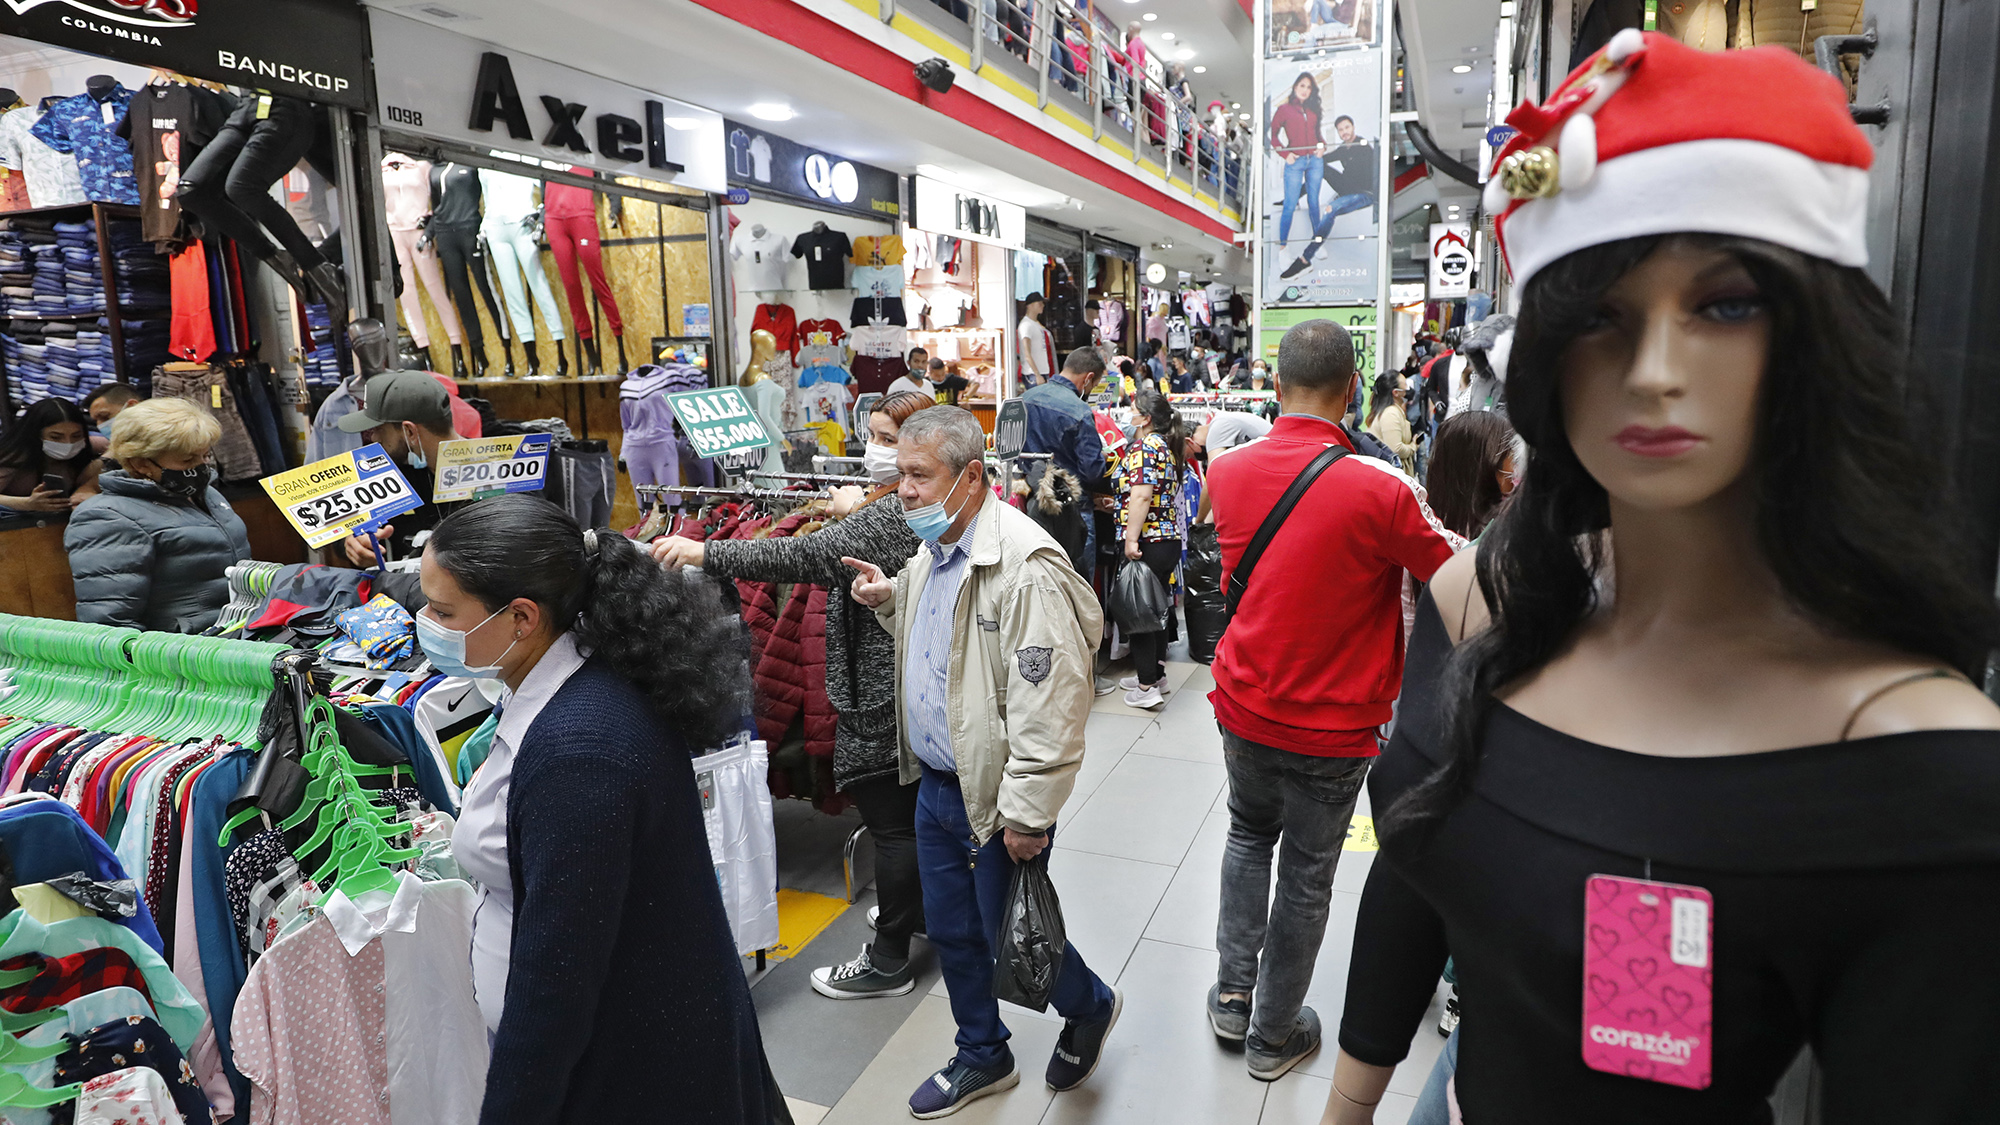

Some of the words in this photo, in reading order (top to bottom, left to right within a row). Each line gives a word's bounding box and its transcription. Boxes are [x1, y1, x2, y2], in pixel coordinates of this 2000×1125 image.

[61, 15, 162, 47] COLOMBIA
[218, 50, 349, 92] BANCKOP
[387, 105, 423, 127] 1098
[1318, 269, 1339, 277] LOC.
[1340, 268, 1367, 277] 23-24
[677, 392, 748, 424] SALE
[443, 447, 473, 458] GRAN
[476, 443, 513, 454] OFERTA
[693, 421, 764, 451] $55.000
[274, 476, 311, 496] GRAN
[309, 463, 352, 484] OFERTA
[306, 487, 319, 496] 100%
[319, 476, 352, 491] COLOMBIANO
[443, 460, 539, 488] $20.000
[297, 476, 402, 528] $25.000
[1589, 1024, 1691, 1059] corazón
